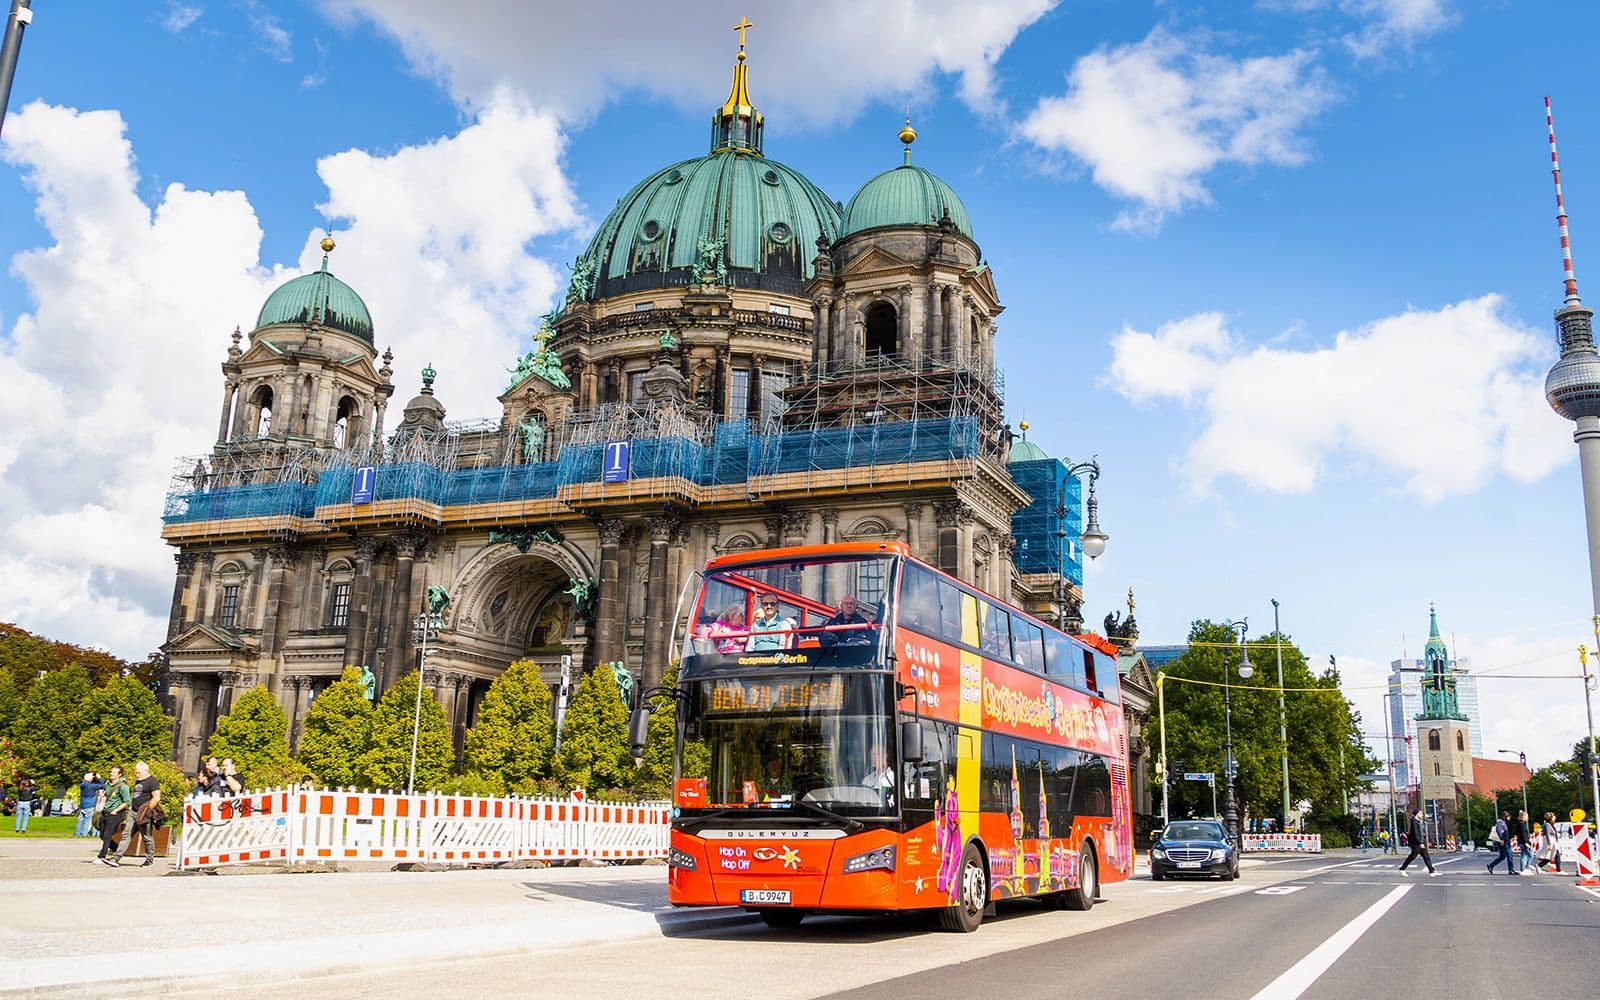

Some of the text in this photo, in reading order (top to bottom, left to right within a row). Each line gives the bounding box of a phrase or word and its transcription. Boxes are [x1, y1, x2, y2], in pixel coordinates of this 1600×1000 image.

[608, 441, 628, 470] T
[357, 466, 374, 492] T
[784, 654, 807, 664] Berlin
[713, 685, 771, 709] BERLIN
[720, 847, 747, 857] Hop On
[722, 860, 750, 870] Hop Off
[766, 892, 786, 901] 9947
